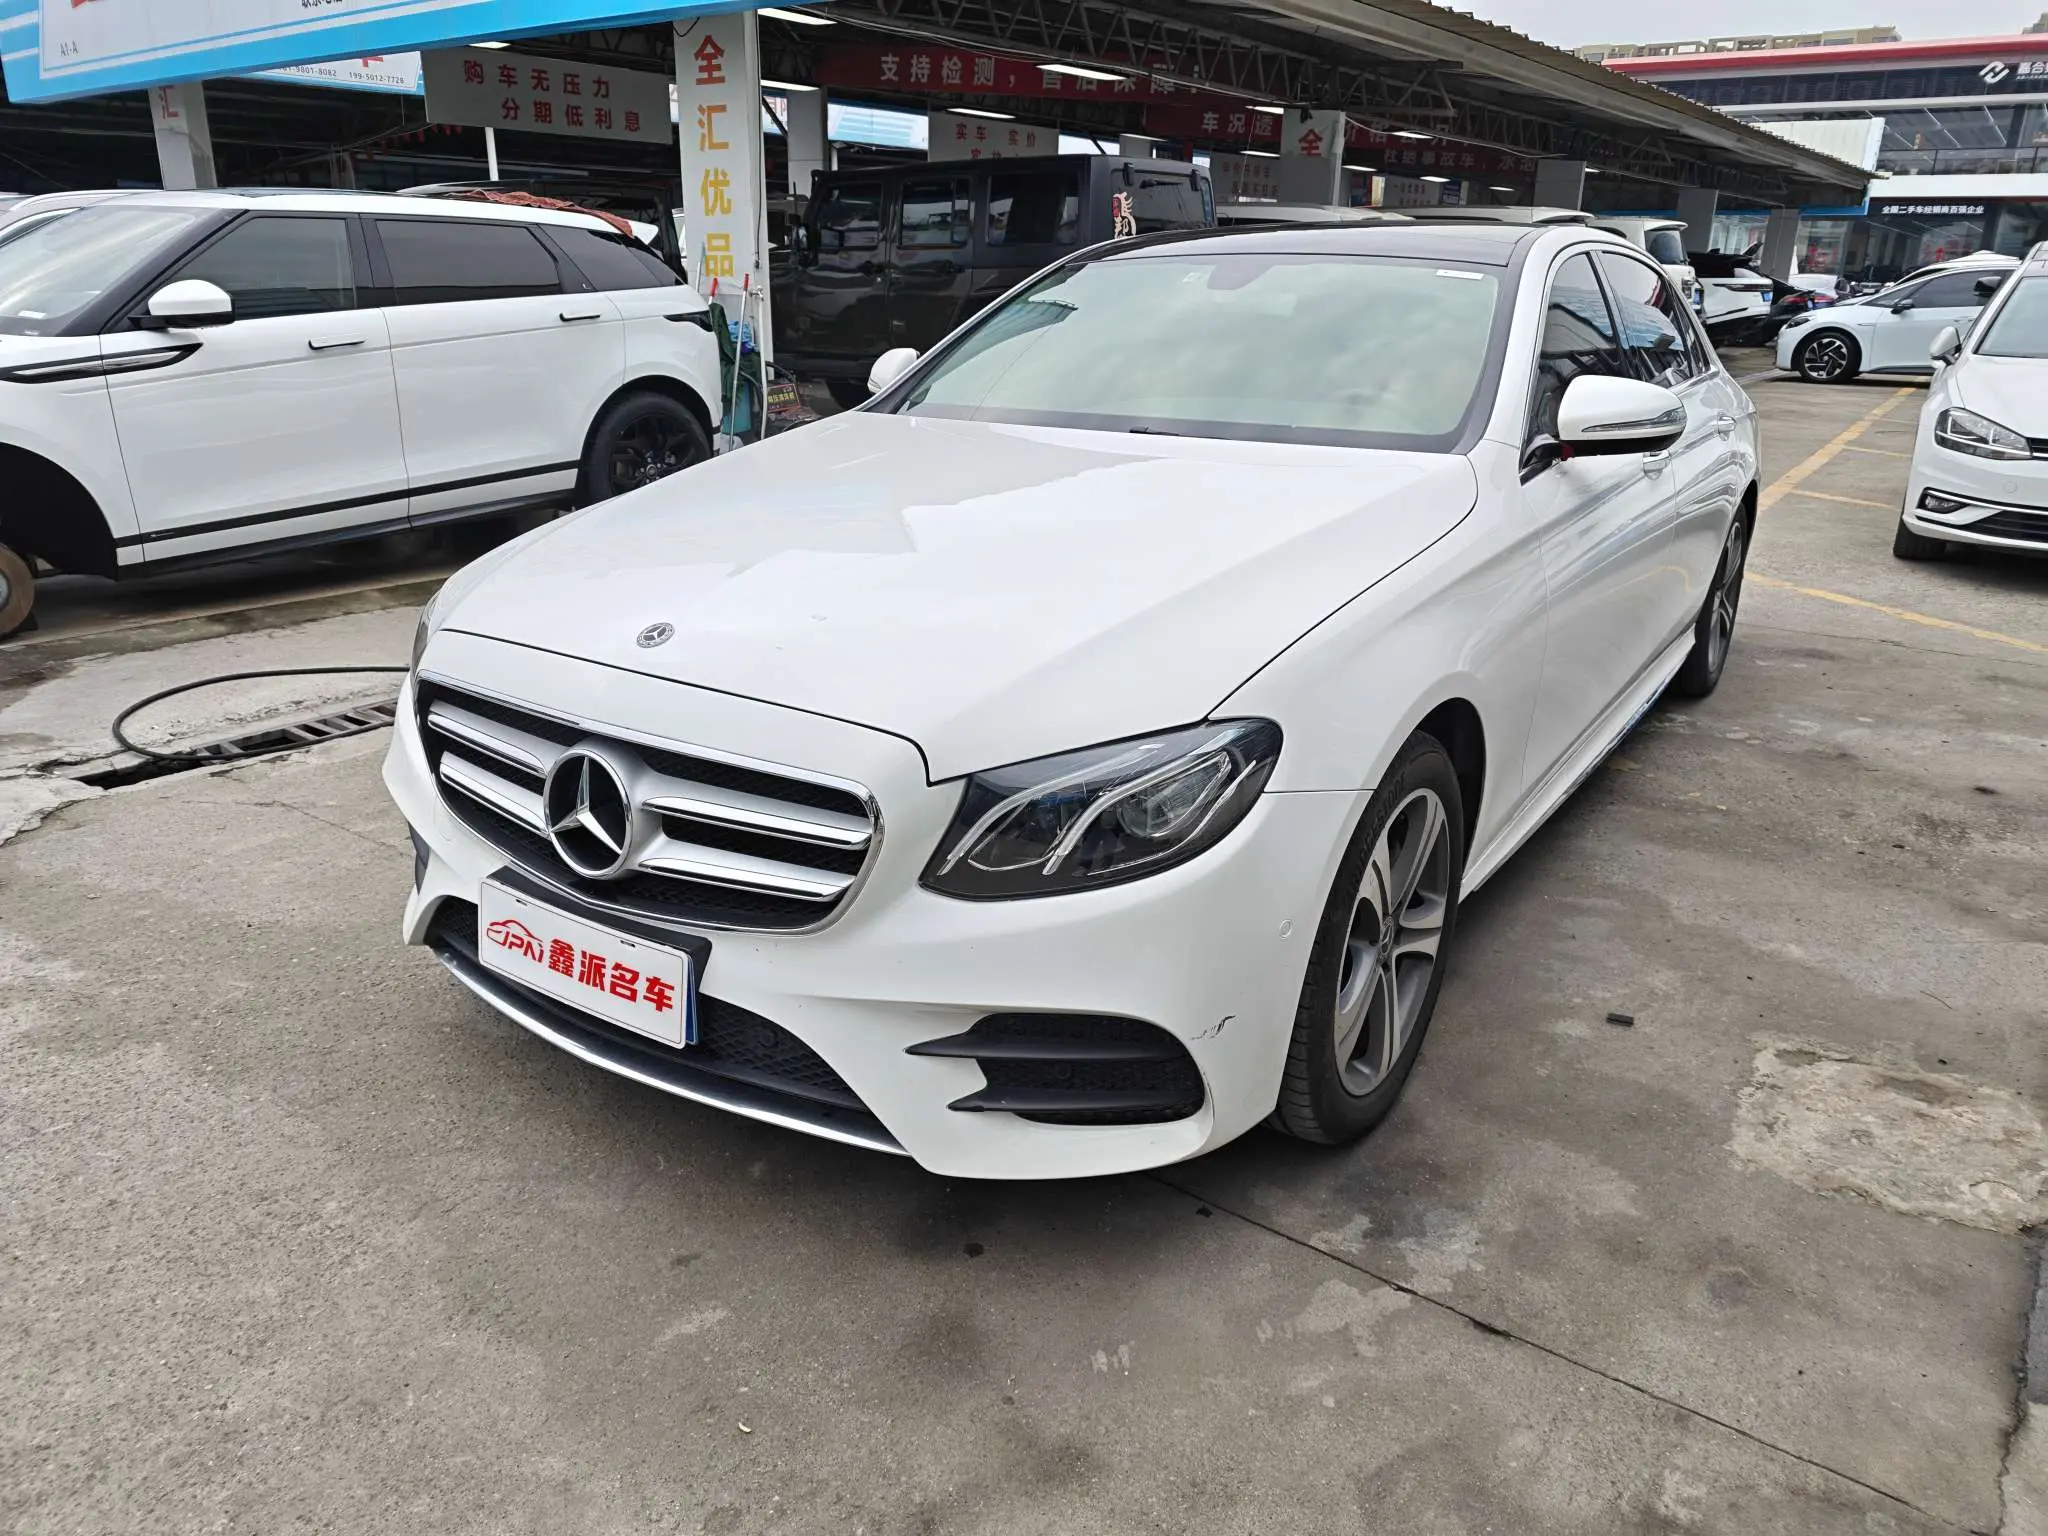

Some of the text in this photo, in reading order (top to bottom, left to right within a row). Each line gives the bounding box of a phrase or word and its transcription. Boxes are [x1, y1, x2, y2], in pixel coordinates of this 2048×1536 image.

[463, 60, 610, 99] 购车无压力
[501, 98, 641, 133] 分期低利息
[693, 34, 735, 276] 全汇优品
[1881, 205, 1985, 215] 全国二手车经销商百强企业
[548, 938, 676, 1012] 鑫派名车
